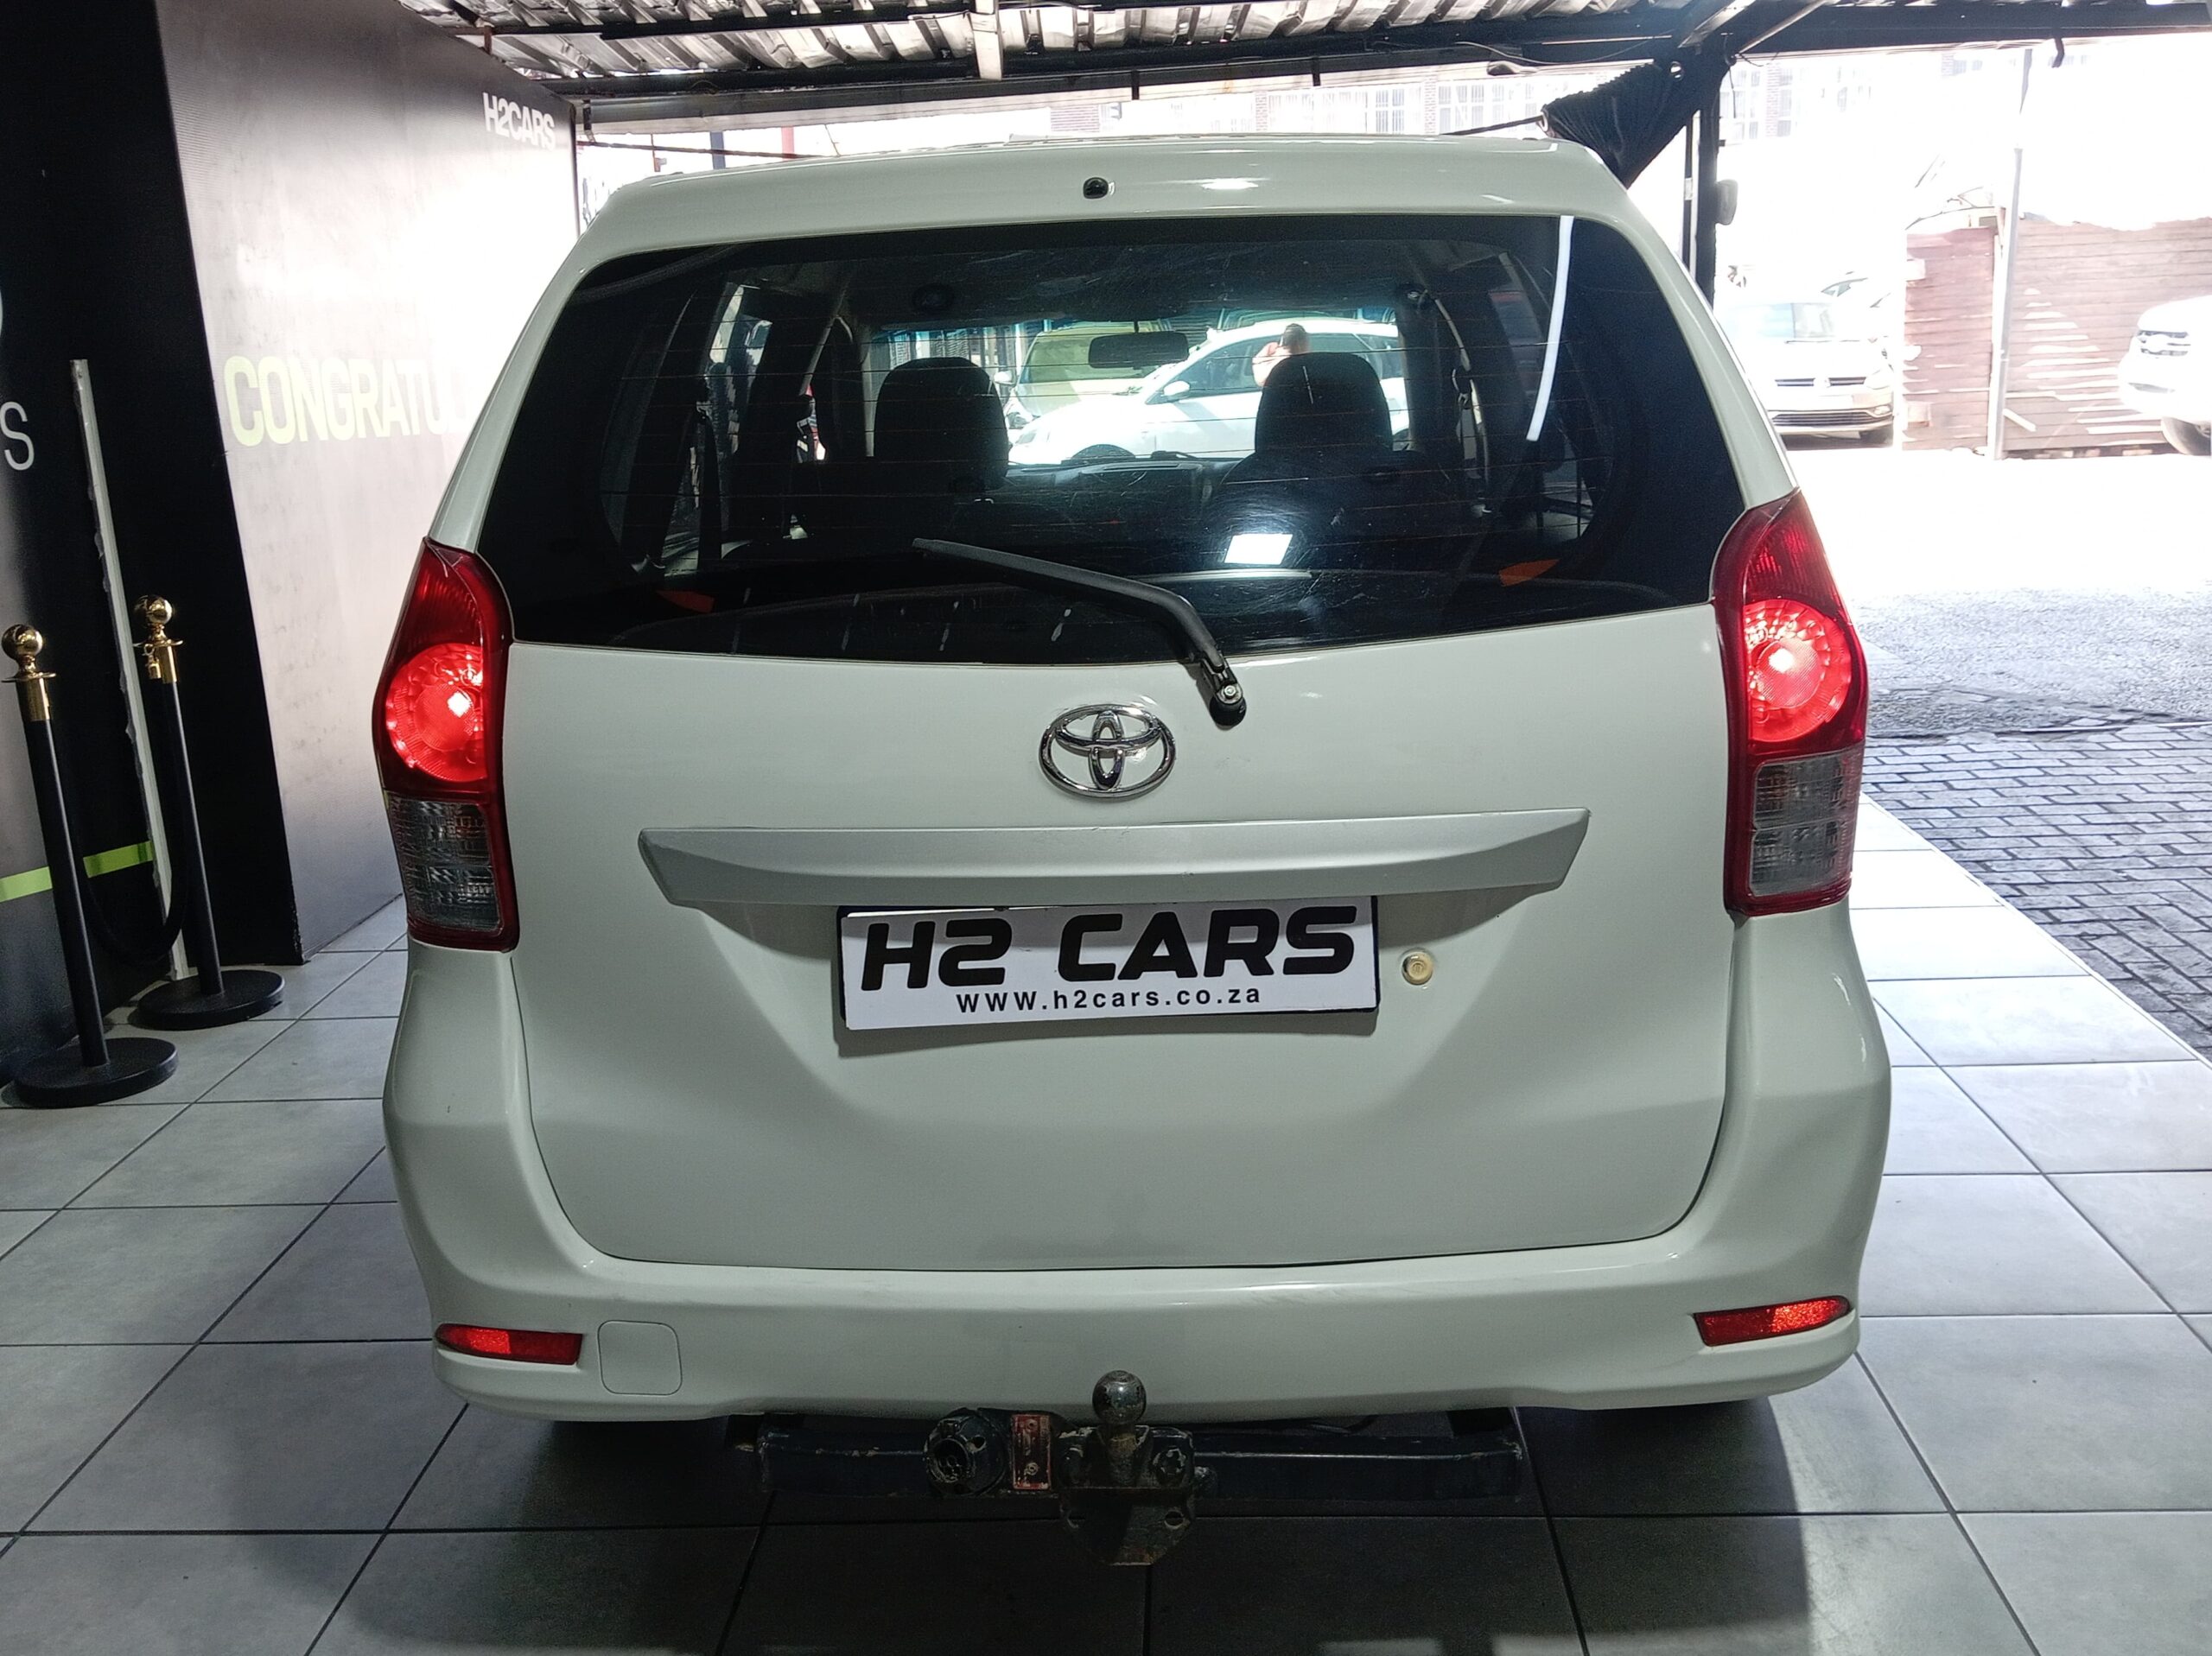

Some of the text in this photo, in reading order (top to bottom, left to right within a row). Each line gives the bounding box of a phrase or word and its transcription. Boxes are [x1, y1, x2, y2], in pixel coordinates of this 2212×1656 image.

[482, 92, 556, 150] H2CARS
[861, 905, 1357, 991] H2 CARS
[957, 988, 1261, 1013] www.h2cars.co.za
